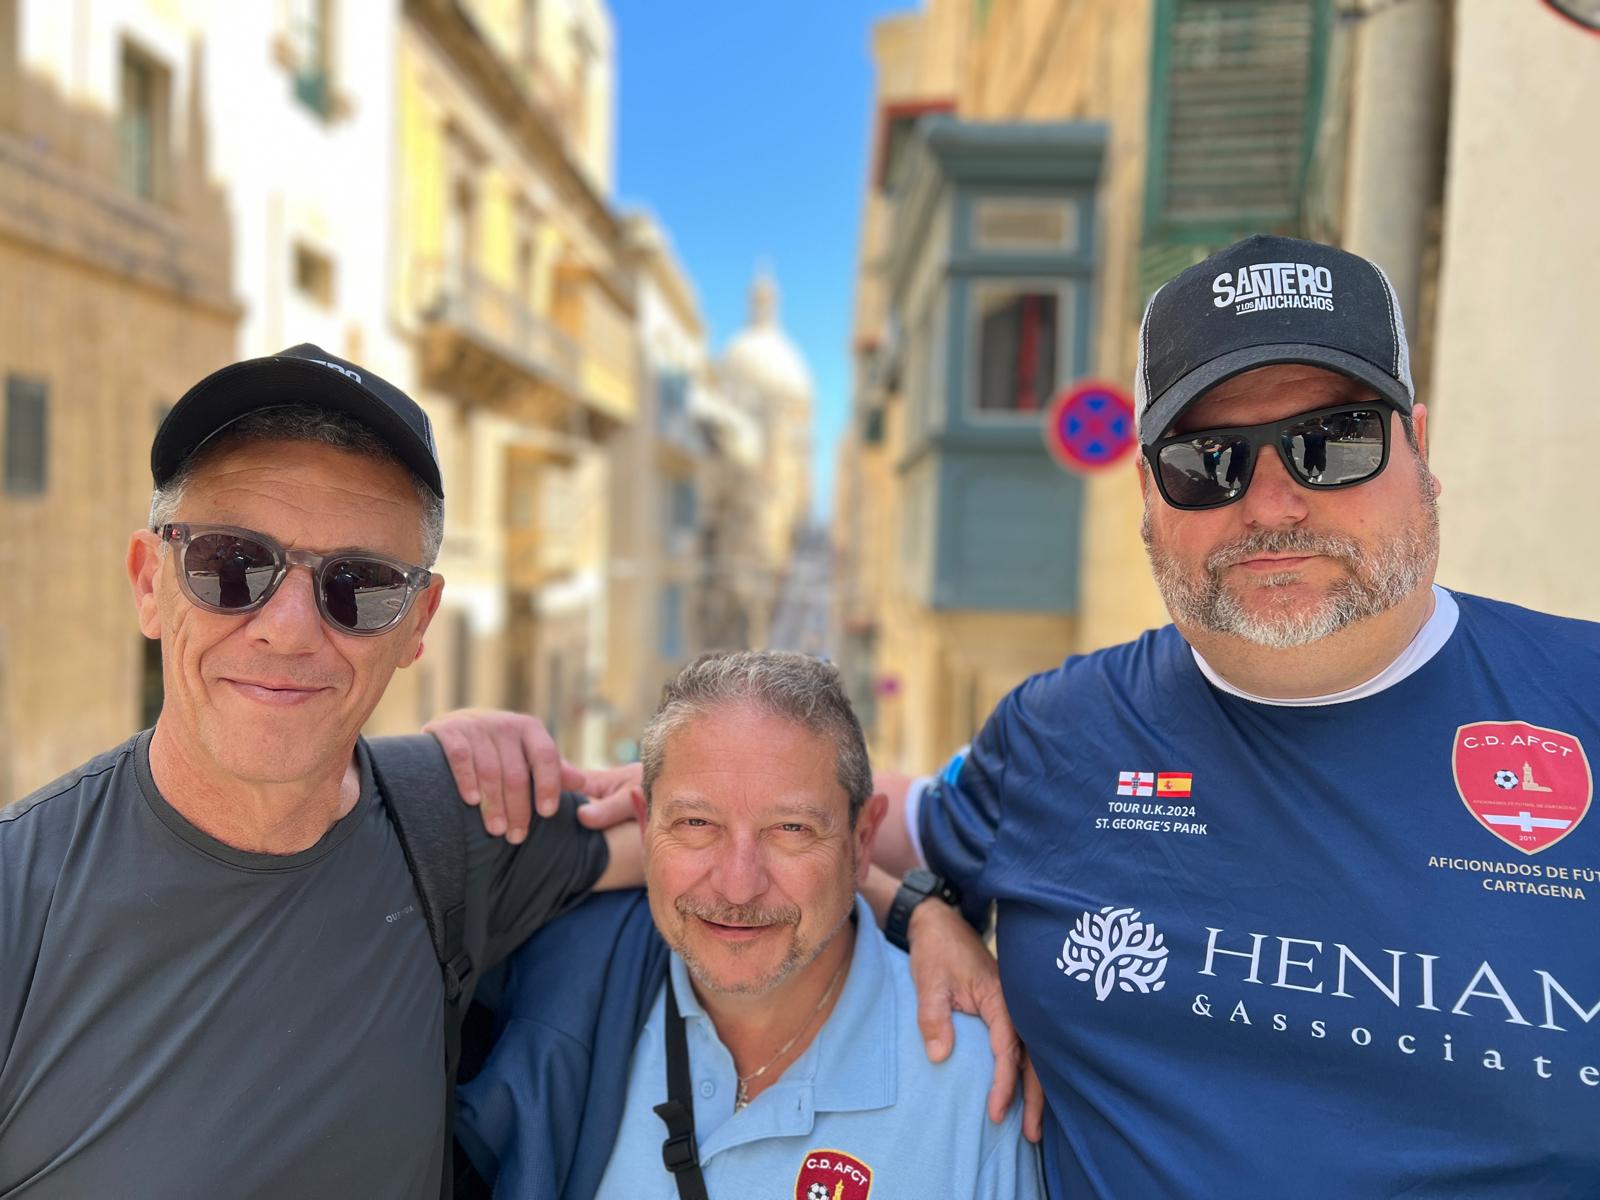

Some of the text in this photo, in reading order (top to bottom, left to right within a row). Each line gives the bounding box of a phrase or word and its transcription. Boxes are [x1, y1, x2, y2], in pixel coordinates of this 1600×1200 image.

[1212, 262, 1333, 308] SANTERO
[1241, 301, 1254, 310] LOS
[1254, 295, 1334, 312] MUCHACHOS
[1463, 735, 1573, 757] C.D. AFCT
[1108, 801, 1196, 817] TOUR U.K.2024
[1095, 818, 1208, 835] ST. GEORGE'S PARK
[1428, 856, 1542, 877] AFICIONADOS
[1546, 866, 1569, 880] DE
[1482, 879, 1586, 900] CARTAGENA
[1191, 994, 1213, 1018] &
[806, 1158, 868, 1186] C.D. AFCT
